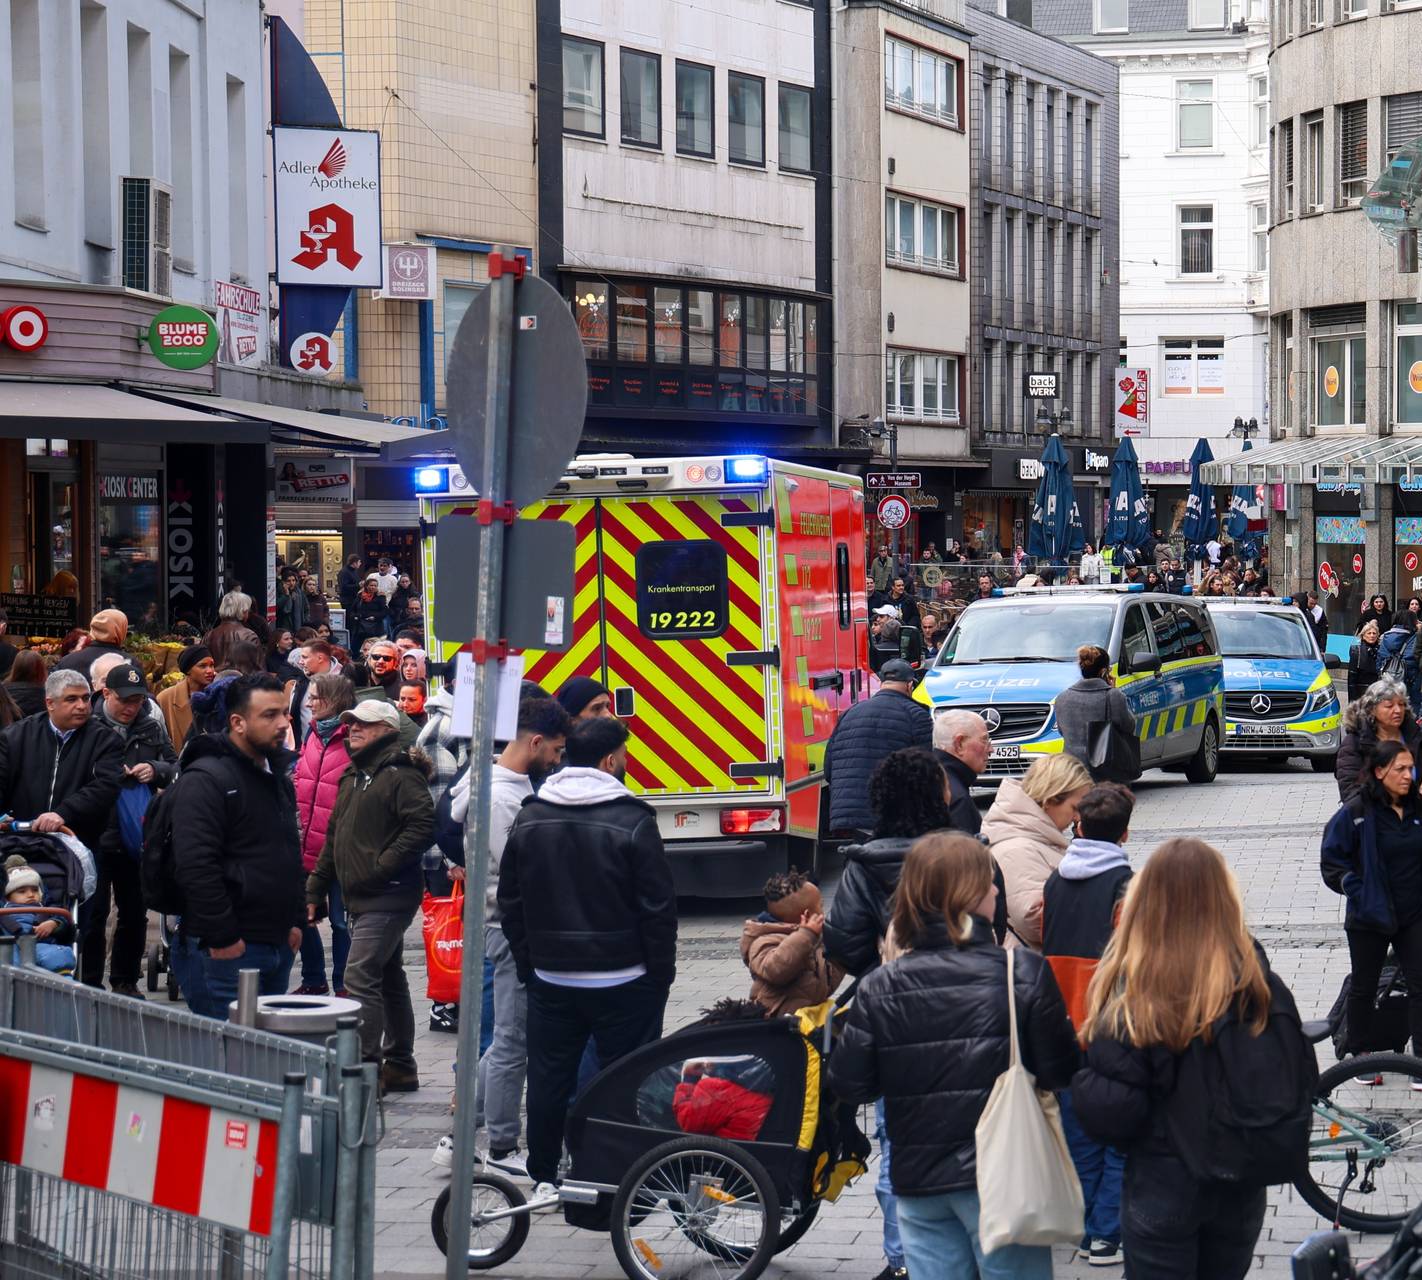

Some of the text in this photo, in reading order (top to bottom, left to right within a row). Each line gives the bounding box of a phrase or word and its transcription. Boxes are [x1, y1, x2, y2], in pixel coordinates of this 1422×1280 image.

[278, 161, 317, 174] Adler
[310, 177, 377, 191] Apotheke
[217, 282, 260, 312] FAHRSCHULE
[158, 323, 208, 335] BLUME
[163, 335, 205, 346] 2000
[1031, 377, 1054, 386] back
[1029, 387, 1056, 396] WERK
[1145, 459, 1193, 475] PARFÜ
[103, 476, 158, 498] KIOSK CENTER
[300, 475, 346, 488] RETTIG
[800, 512, 831, 537] FEUERWEHR
[168, 501, 194, 598] KIOSK
[802, 565, 811, 590] 112
[647, 584, 716, 594] Krankentransport
[1223, 670, 1291, 679] POLIZEI
[954, 679, 1041, 690] POLIZEI
[1241, 725, 1256, 734] NRW
[996, 747, 1018, 758] 4525
